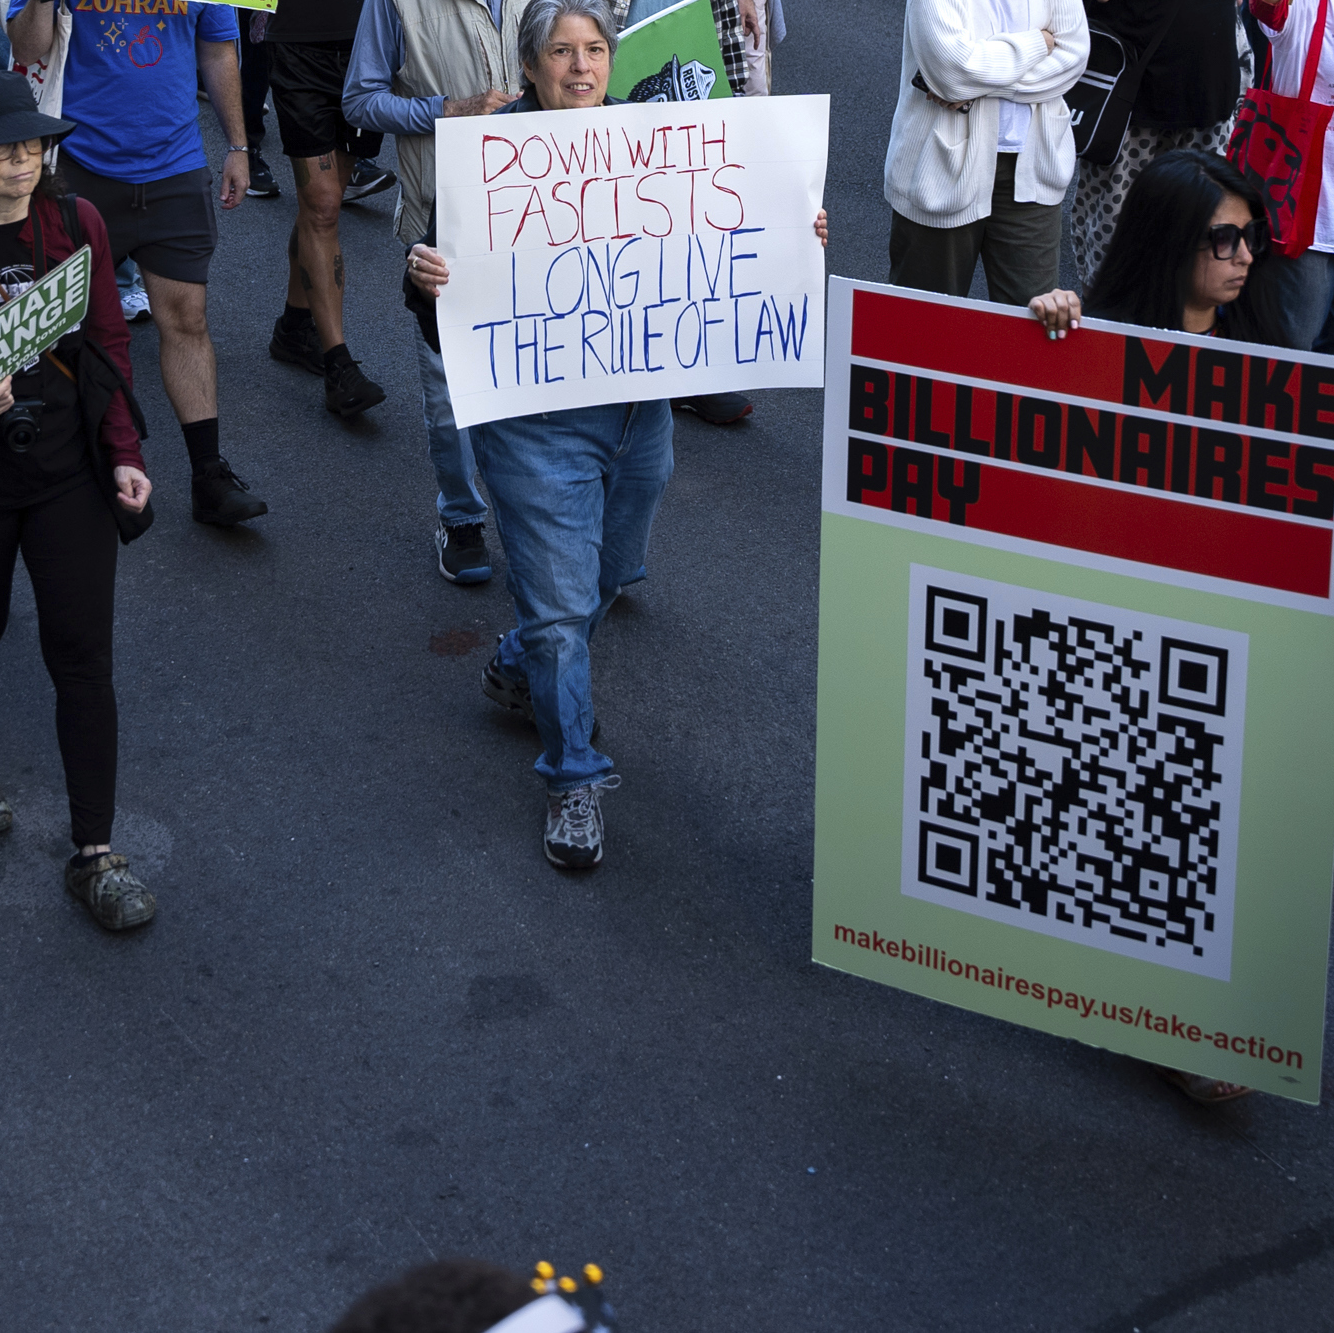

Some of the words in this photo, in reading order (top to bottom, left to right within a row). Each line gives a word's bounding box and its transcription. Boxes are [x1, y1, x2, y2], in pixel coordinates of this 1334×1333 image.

[482, 127, 611, 183] DOWN
[622, 120, 726, 169] WITH
[488, 163, 746, 251] FASCISTS
[512, 236, 642, 319] LONG
[660, 227, 765, 304] LIVE
[7, 352, 20, 366] to
[23, 344, 31, 353] a
[35, 318, 66, 344] town
[472, 314, 565, 389] THE
[581, 303, 664, 378] RULE
[674, 298, 725, 369] OF
[734, 293, 808, 364] LAW
[846, 436, 981, 527] PAY
[833, 922, 1304, 1069] makebillionairespay.us/take-action
